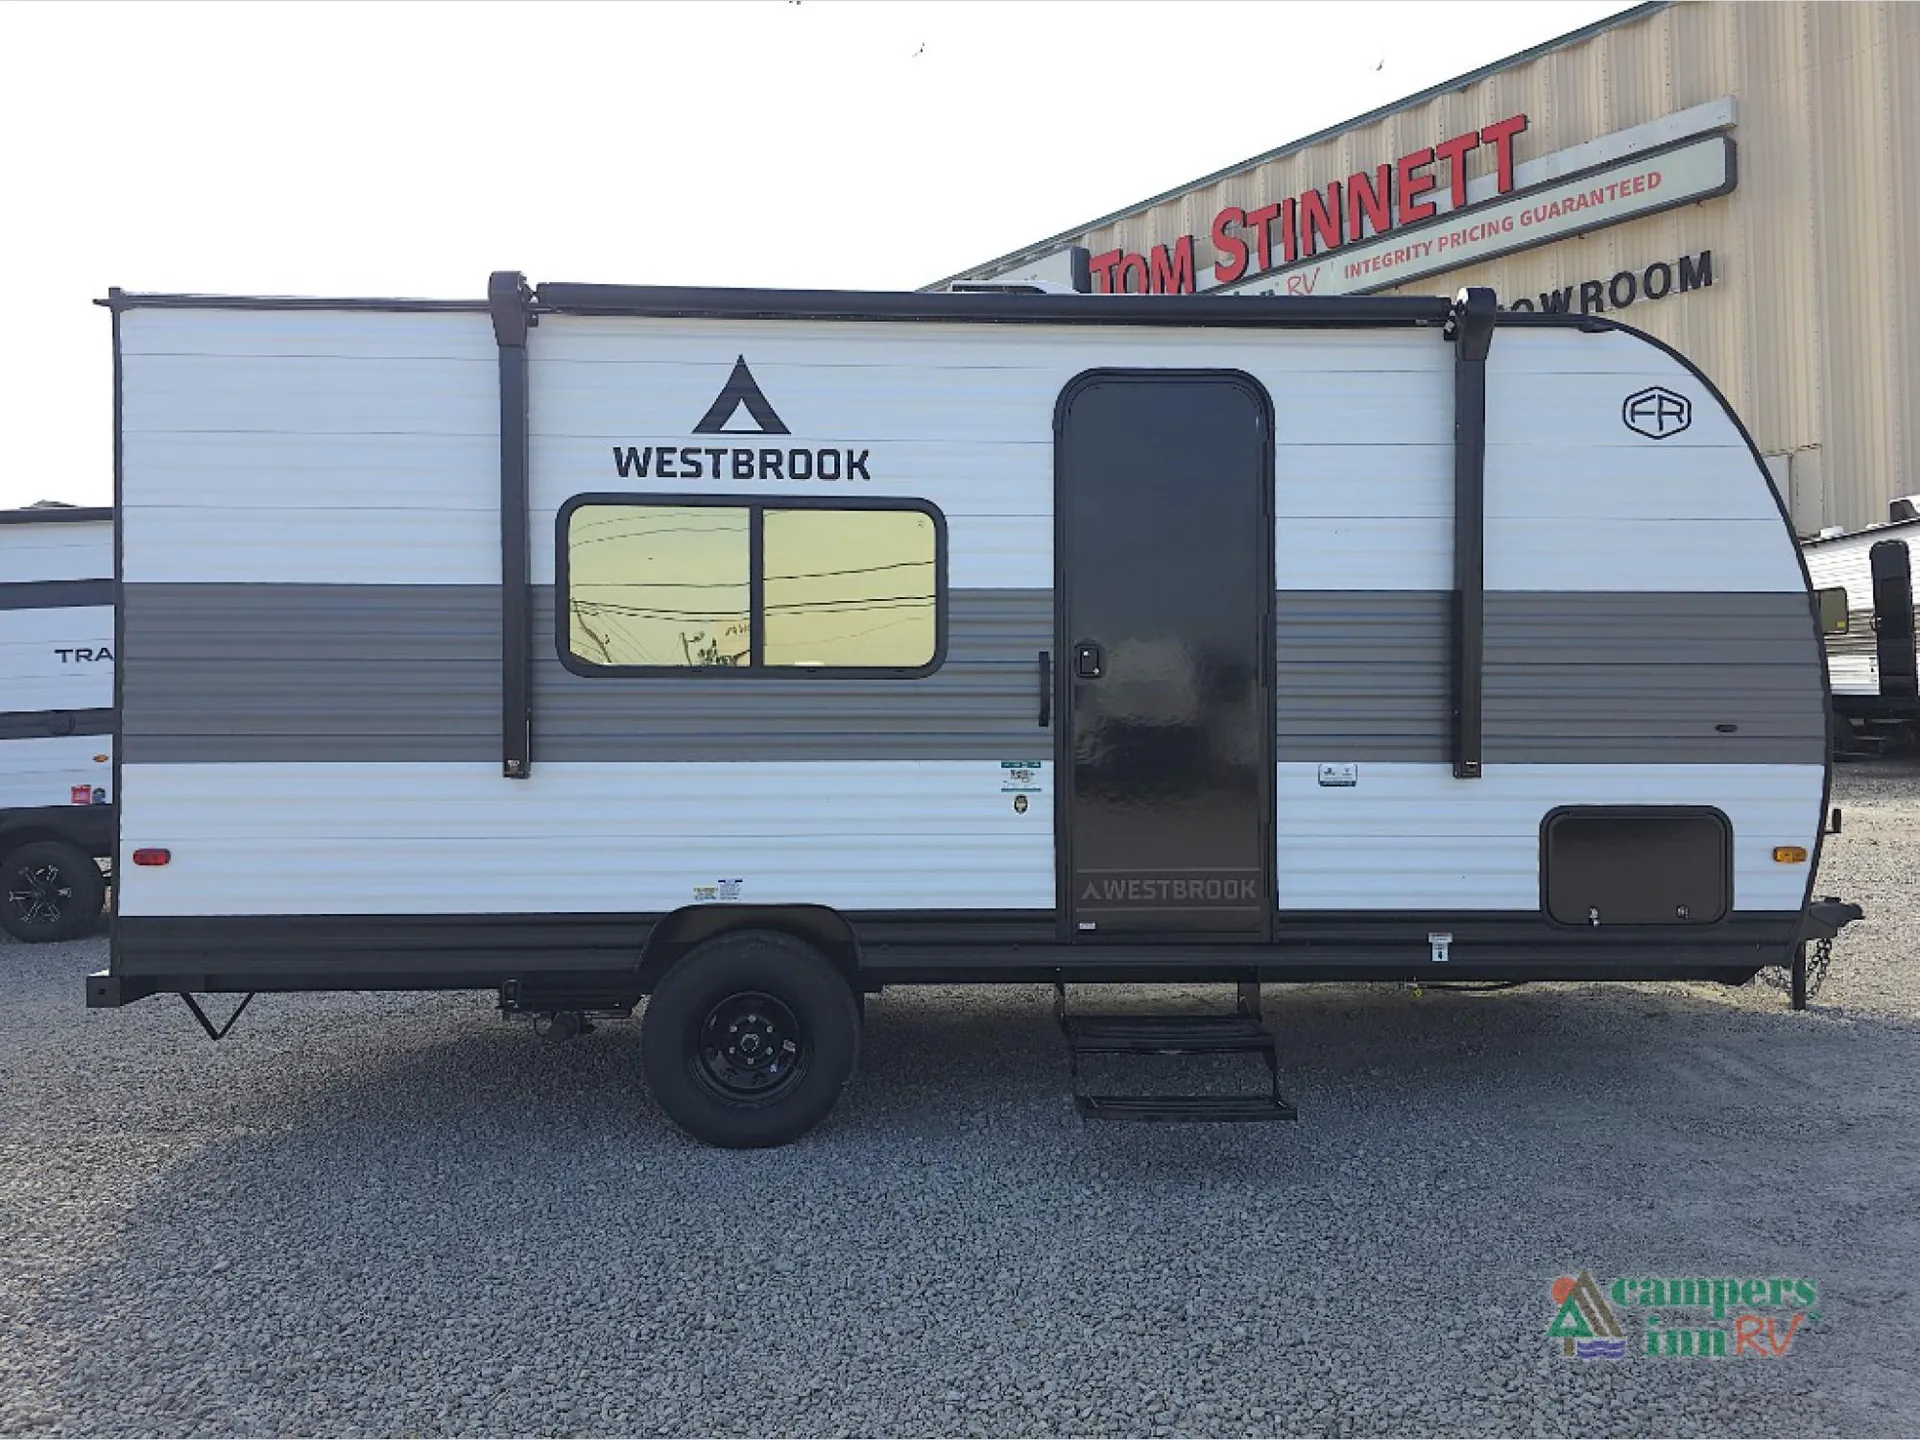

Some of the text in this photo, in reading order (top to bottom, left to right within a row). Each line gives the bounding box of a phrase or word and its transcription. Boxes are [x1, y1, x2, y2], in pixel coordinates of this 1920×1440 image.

[1089, 114, 1528, 294] TOM STINNETT
[1344, 171, 1663, 279] INTEGRITY PRICING GUARANTEED
[1286, 267, 1321, 295] RV
[613, 446, 871, 480] WESTBROOK
[1104, 879, 1257, 900] WESTBROOK
